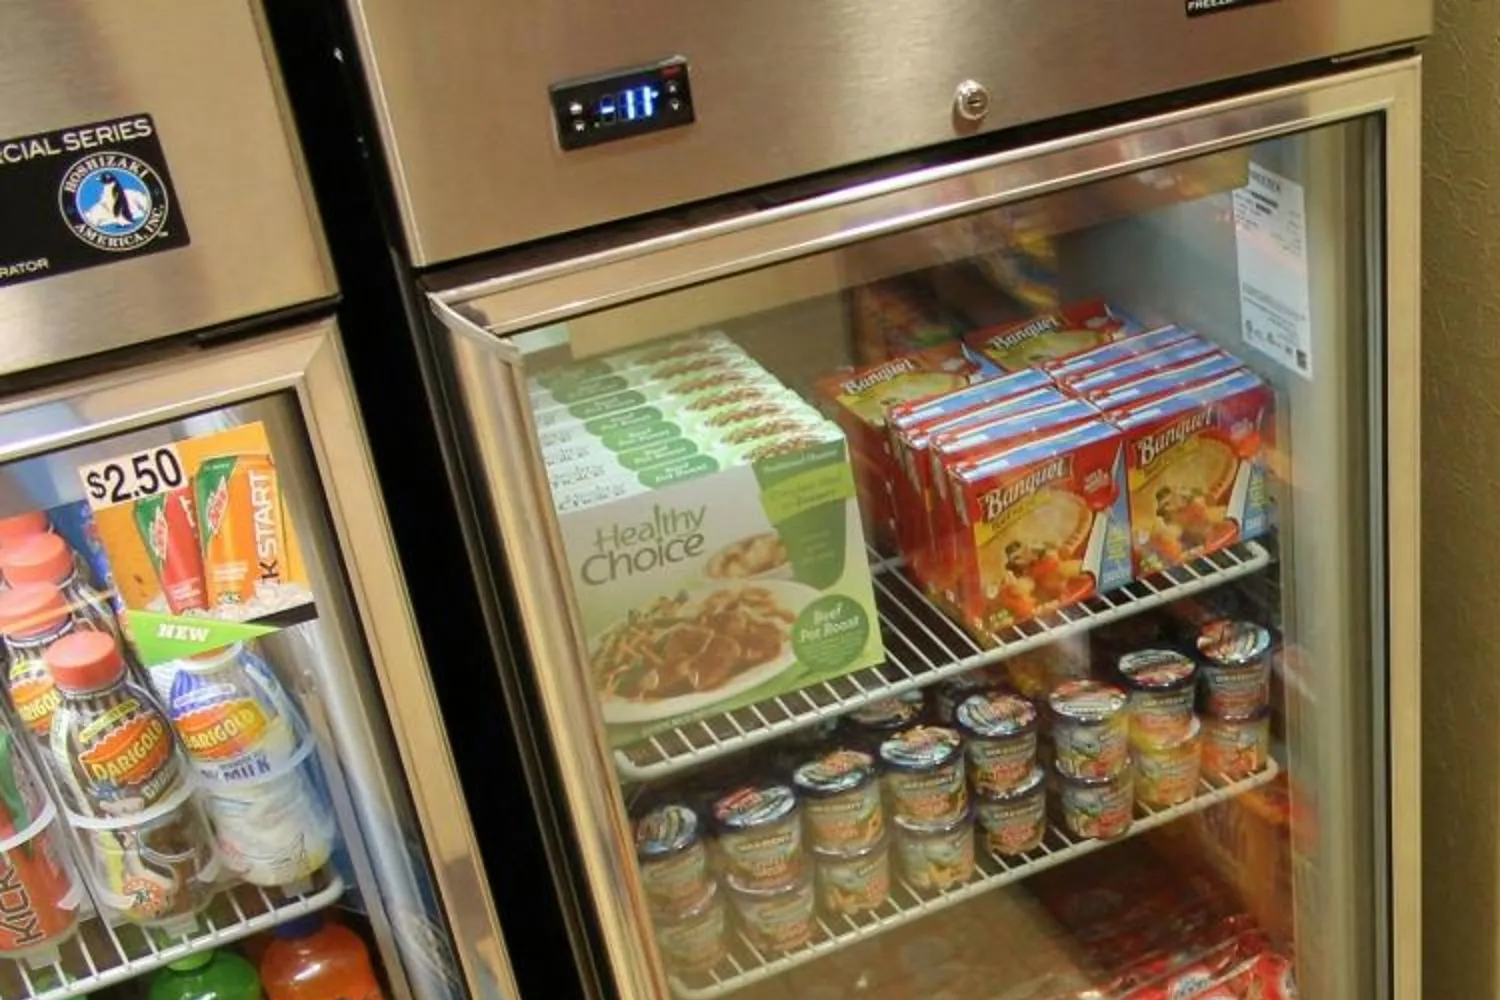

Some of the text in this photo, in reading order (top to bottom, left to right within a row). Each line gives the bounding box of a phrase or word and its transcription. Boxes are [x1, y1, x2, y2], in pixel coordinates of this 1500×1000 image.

[63, 118, 152, 151] SERIES
[64, 155, 149, 193] HOSHIZAKI
[990, 315, 1059, 351] Banquet
[842, 358, 914, 395] Banquet
[1137, 408, 1213, 466] Banquet
[86, 447, 182, 503] $2.50
[984, 459, 1068, 520] Banquet
[594, 504, 709, 552] Healthy
[581, 533, 706, 587] Choice
[156, 622, 211, 642] NEW
[91, 718, 164, 780] DARIGOLD
[223, 756, 271, 783] MILK
